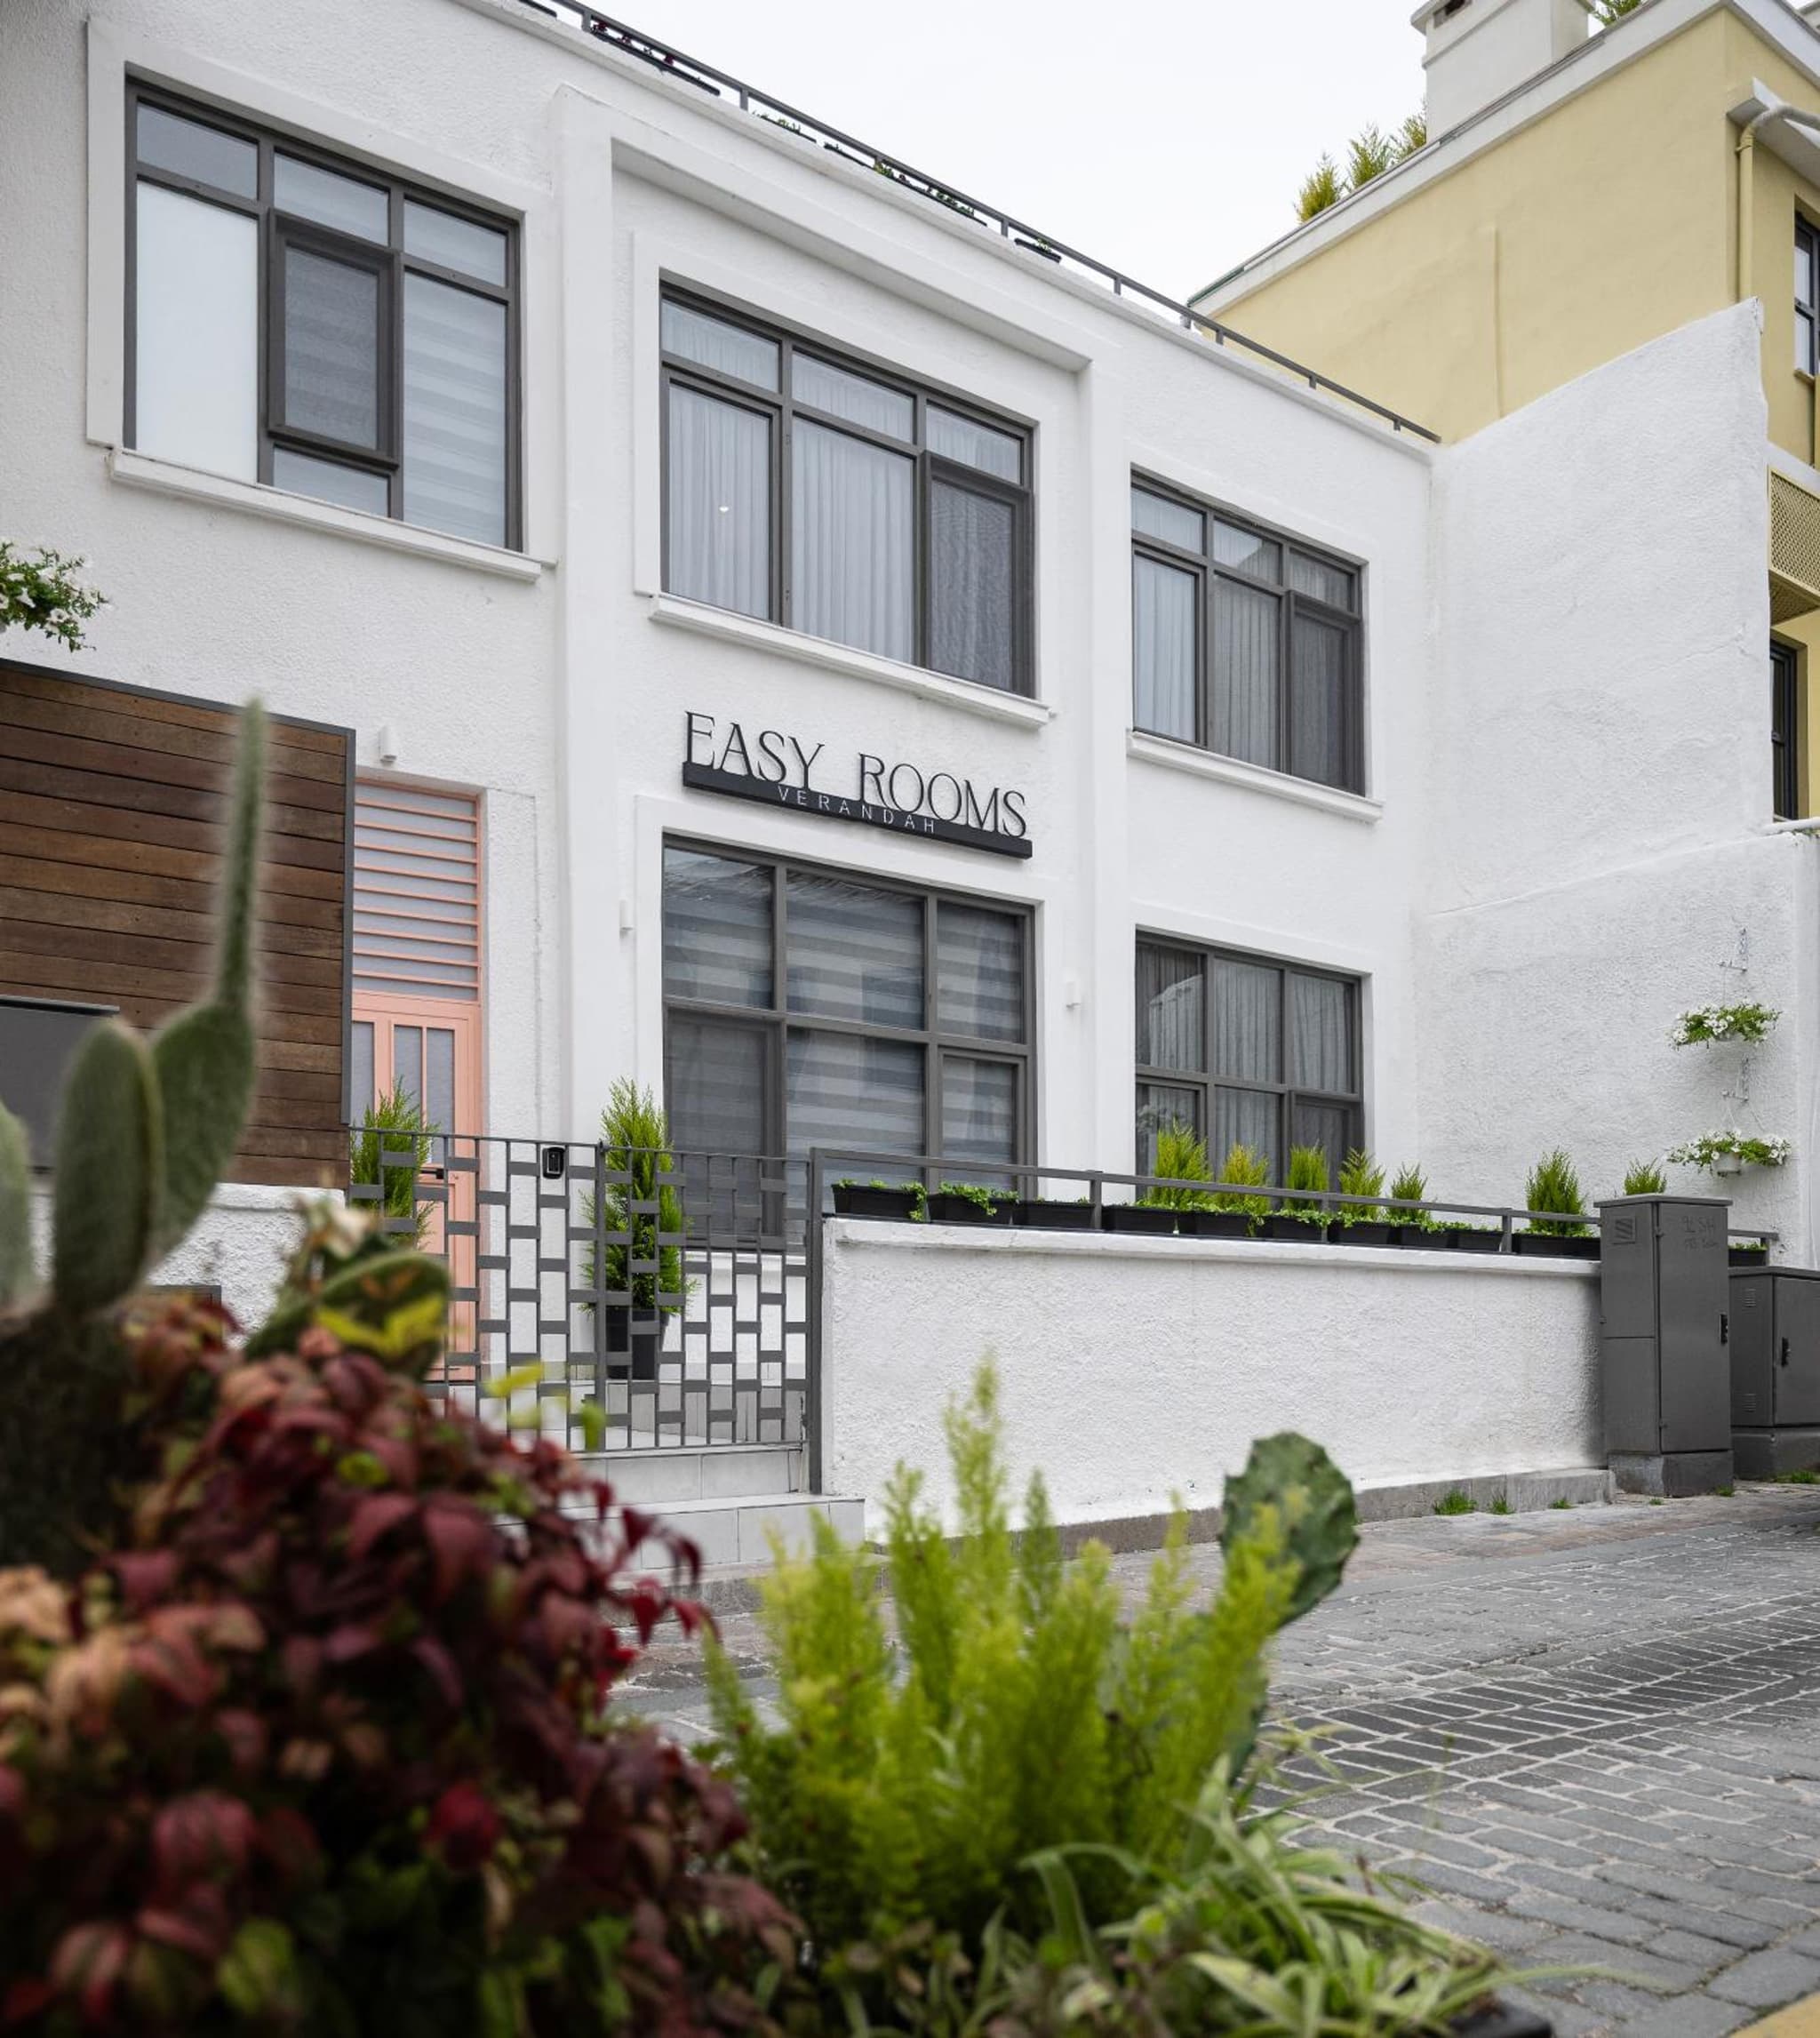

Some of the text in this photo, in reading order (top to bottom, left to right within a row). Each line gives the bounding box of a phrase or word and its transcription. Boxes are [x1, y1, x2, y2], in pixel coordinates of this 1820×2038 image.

[685, 711, 1026, 837] EASY ROOMS
[777, 785, 934, 833] VERANDAH
